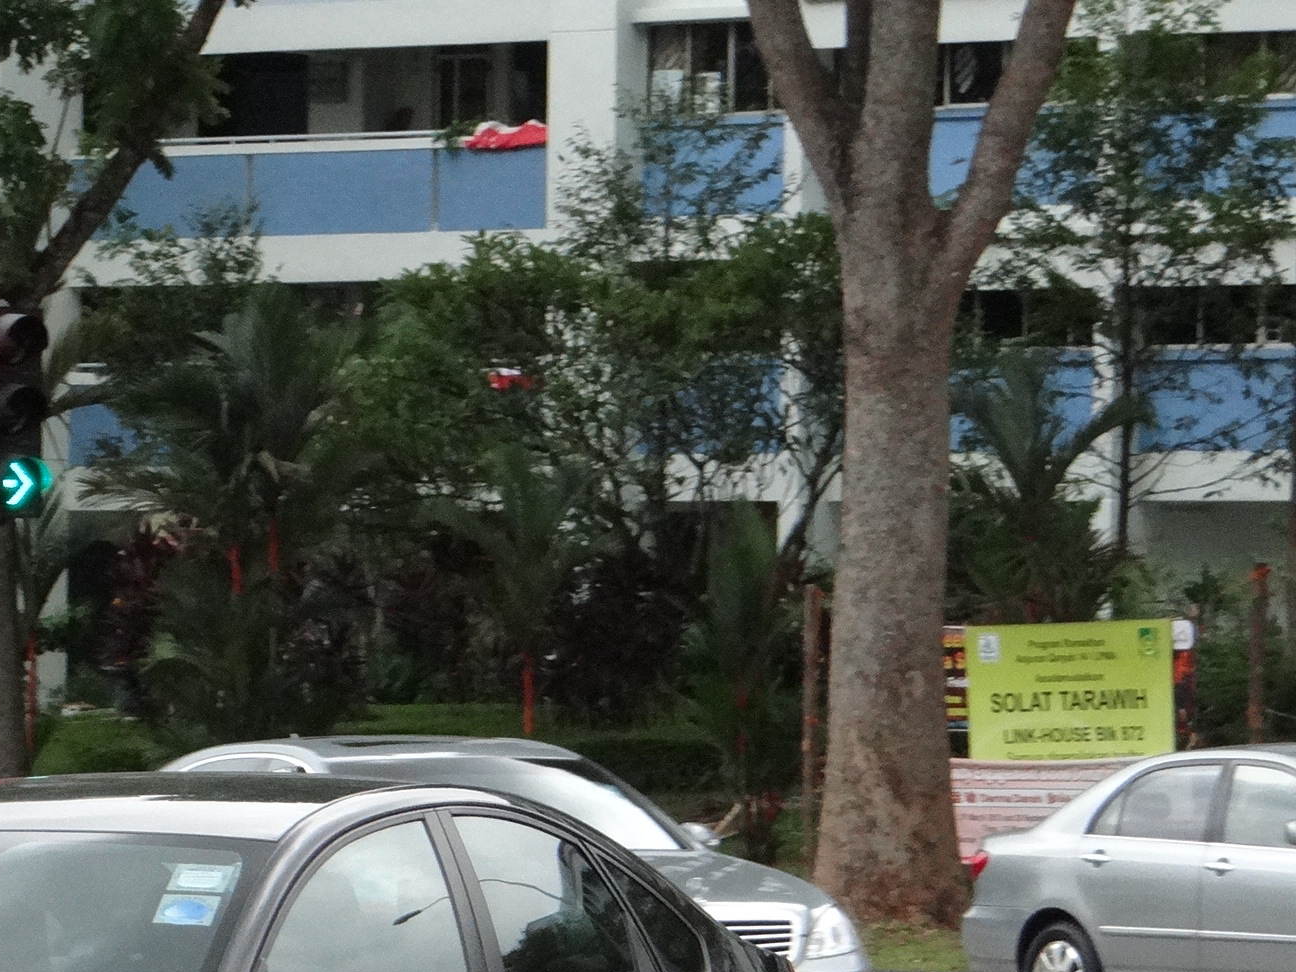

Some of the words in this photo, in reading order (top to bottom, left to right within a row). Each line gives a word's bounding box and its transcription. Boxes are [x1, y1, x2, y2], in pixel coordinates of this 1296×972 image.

[990, 690, 1053, 713] SOLAT
[1058, 688, 1149, 711] TARAWIH
[1003, 726, 1091, 744] LINK-HOUSE
